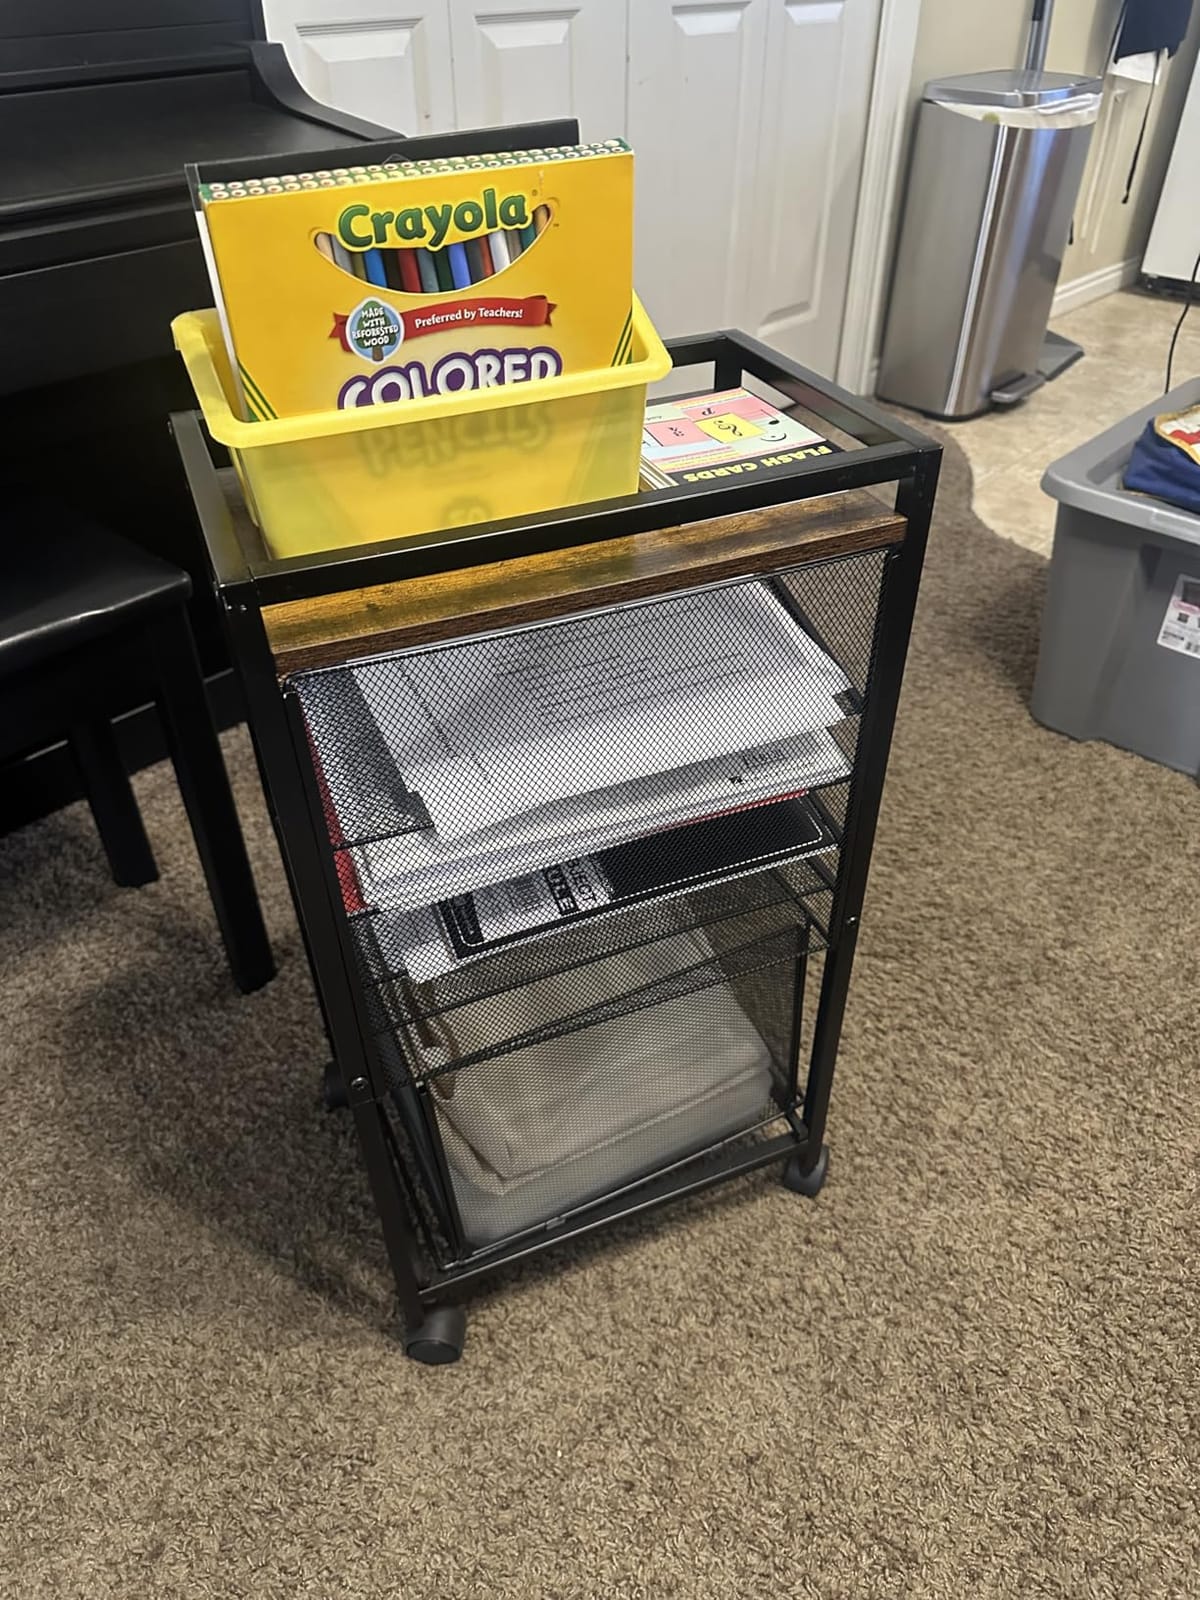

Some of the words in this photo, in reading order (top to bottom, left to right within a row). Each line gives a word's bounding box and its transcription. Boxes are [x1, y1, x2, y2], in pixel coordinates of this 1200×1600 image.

[338, 188, 528, 248] Crayola
[361, 307, 385, 318] MADE
[415, 309, 462, 328] Preferred
[463, 308, 477, 321] by
[478, 307, 524, 319] Teachers!
[362, 317, 386, 328] WITH
[352, 325, 399, 340] REFORESTED
[363, 336, 390, 347] WOOD
[760, 445, 833, 468] FLASH
[683, 462, 757, 482] CARDS
